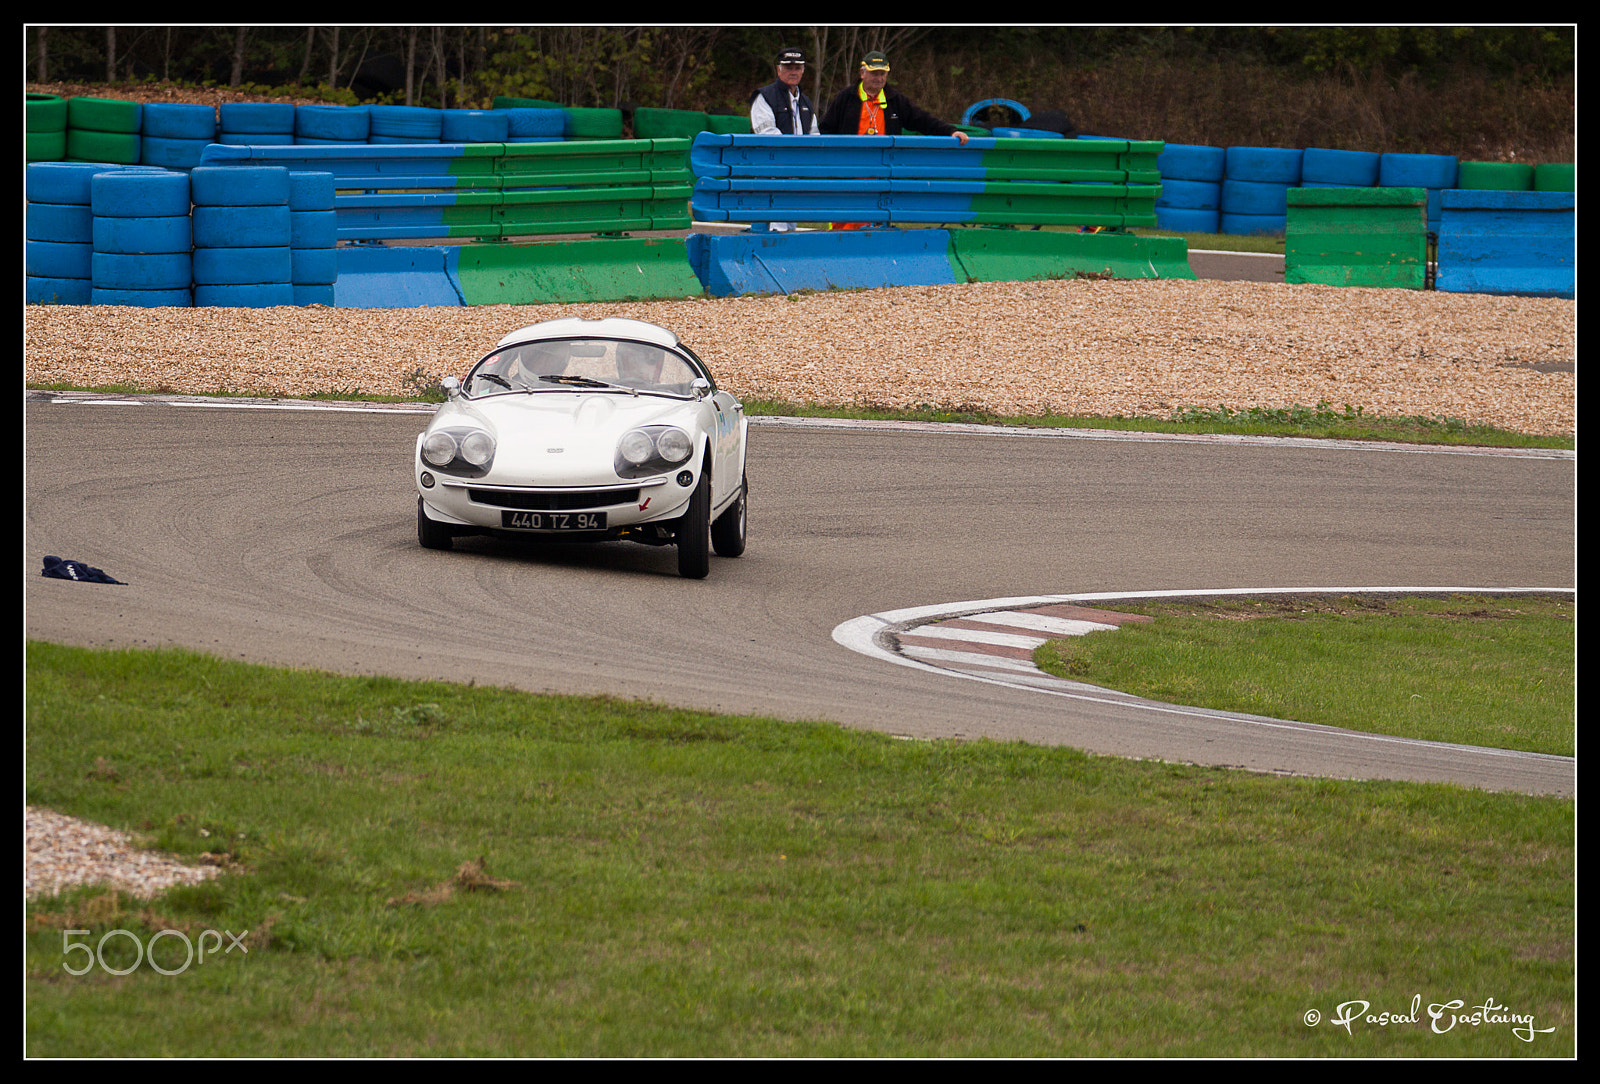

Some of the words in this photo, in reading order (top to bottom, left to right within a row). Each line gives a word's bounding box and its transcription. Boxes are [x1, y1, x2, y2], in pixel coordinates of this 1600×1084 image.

[511, 513, 542, 528] 440
[549, 514, 570, 529] TZ
[577, 514, 598, 529] 94
